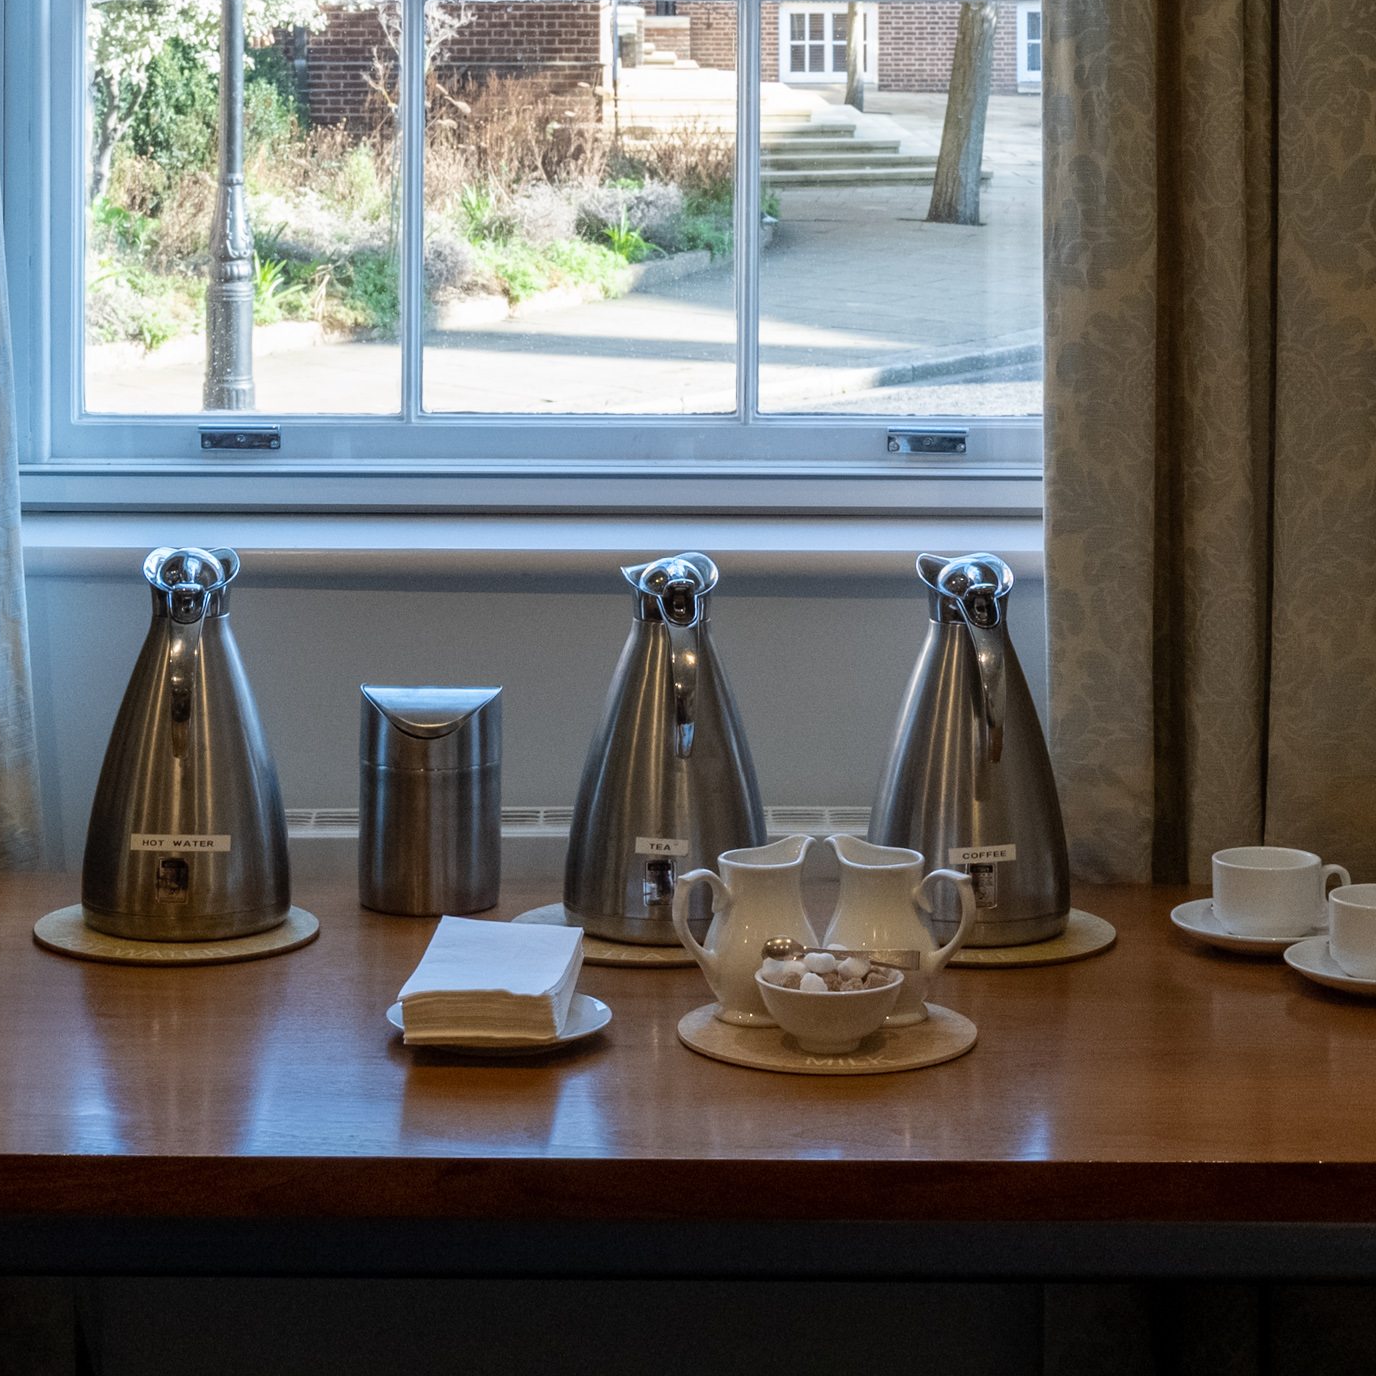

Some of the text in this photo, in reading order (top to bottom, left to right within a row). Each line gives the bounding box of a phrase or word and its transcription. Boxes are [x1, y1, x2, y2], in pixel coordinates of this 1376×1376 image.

[649, 843, 671, 851] TEA
[962, 850, 1007, 860] COFFEE
[115, 948, 229, 959] WATER
[805, 1055, 896, 1065] MILK
